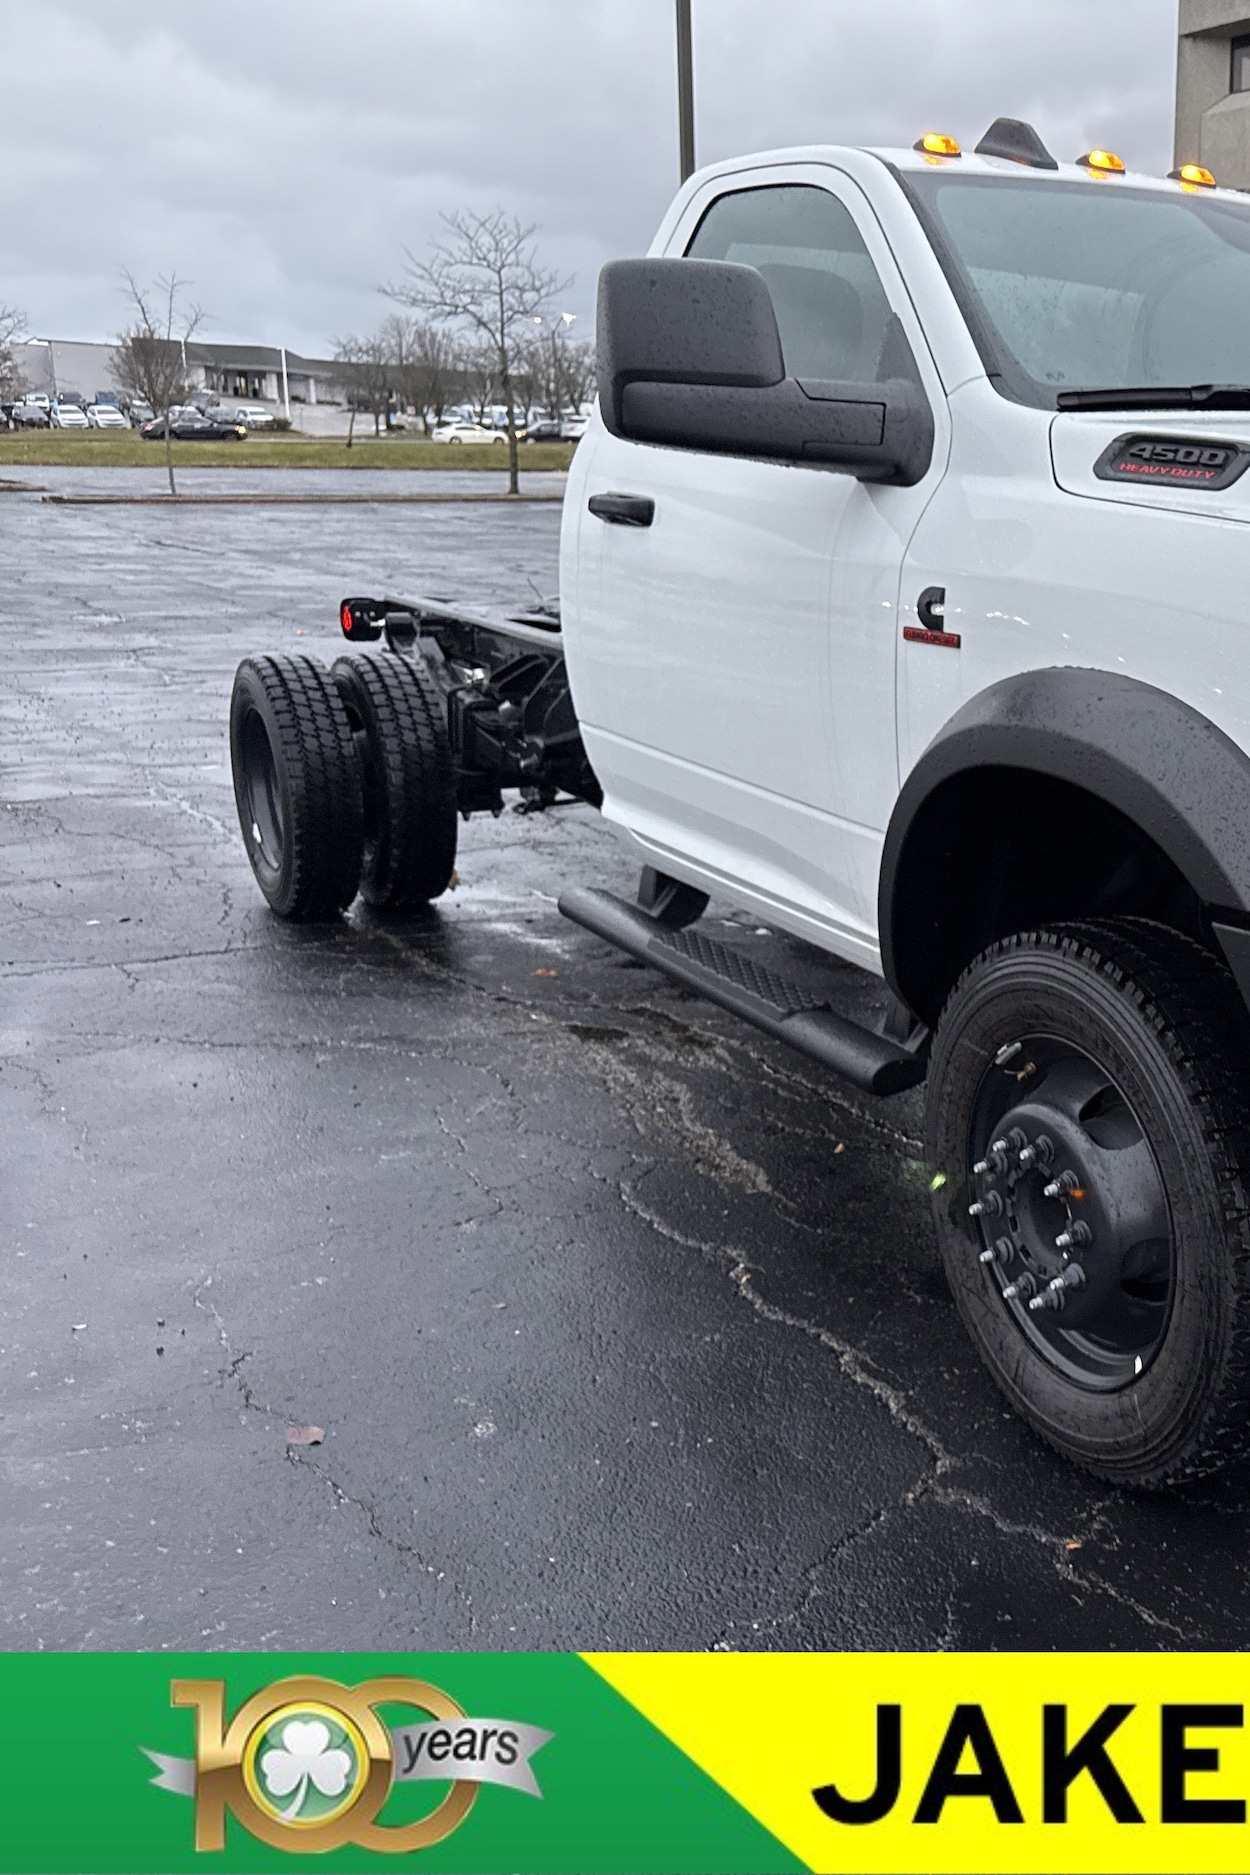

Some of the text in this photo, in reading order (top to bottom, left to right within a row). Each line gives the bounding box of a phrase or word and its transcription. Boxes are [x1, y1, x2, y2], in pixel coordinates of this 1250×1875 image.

[1130, 443, 1227, 465] 4500
[1119, 462, 1216, 479] HEAVY DUTY
